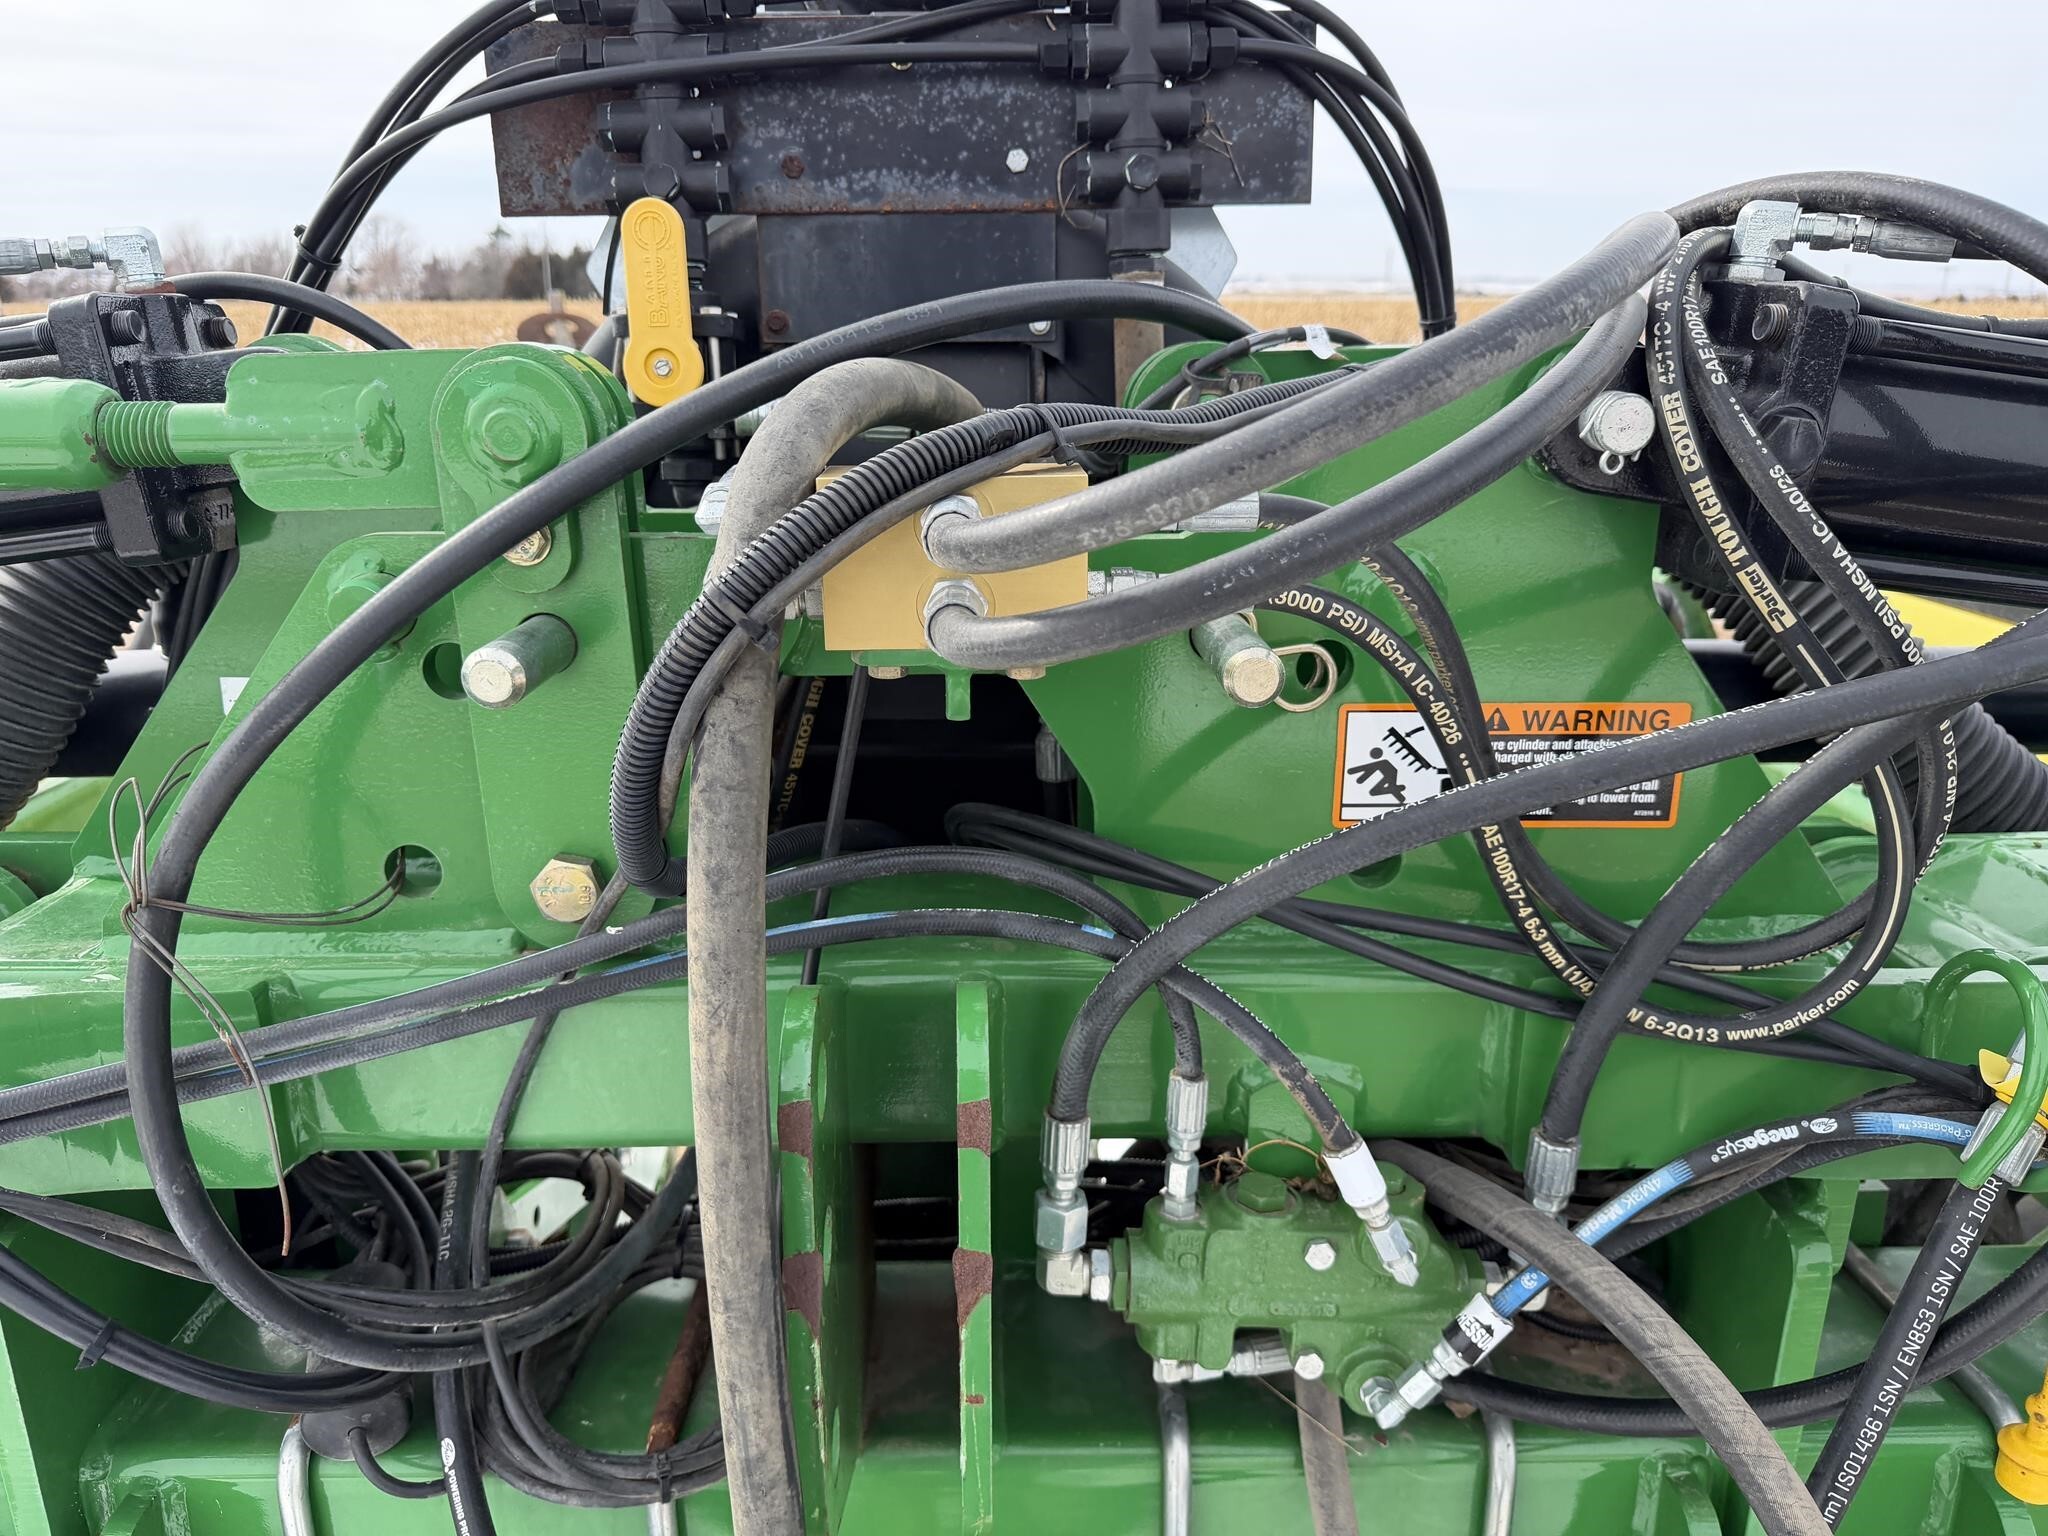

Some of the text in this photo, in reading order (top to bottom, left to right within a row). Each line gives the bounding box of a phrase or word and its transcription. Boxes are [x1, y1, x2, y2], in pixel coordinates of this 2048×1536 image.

[1660, 390, 1790, 632] Parker TOUGH COVER
[1831, 541, 1878, 602] MSHA
[1874, 598, 1906, 639] PSI)
[1326, 602, 1368, 635] PSI)
[1365, 627, 1417, 679] MSHA
[1411, 673, 1464, 745] IC-40/26
[1522, 708, 1672, 733] WARNING
[789, 713, 815, 769] COVER
[1495, 751, 1532, 765] harged
[1507, 738, 1550, 753] cylinder
[1552, 739, 1571, 751] and
[1600, 793, 1629, 804] lower
[1630, 793, 1656, 804] from
[1481, 824, 1529, 918] AE100R17-4
[1523, 915, 1541, 942] 6,3
[1538, 939, 1567, 970] mm
[1643, 1014, 1719, 1043] 6-2Q13
[1726, 977, 1861, 1042] www.parker.com
[1625, 1176, 1662, 1210] 4M3K
[1950, 1220, 1979, 1259] SAE
[1944, 1256, 1963, 1272] /
[1925, 1270, 1954, 1309] 1SN
[1897, 1308, 1937, 1365] EN853
[1891, 1366, 1908, 1381] /
[1873, 1381, 1903, 1418] 1SN
[1836, 1417, 1884, 1490] ISO1436
[448, 1468, 465, 1521] POWERING
